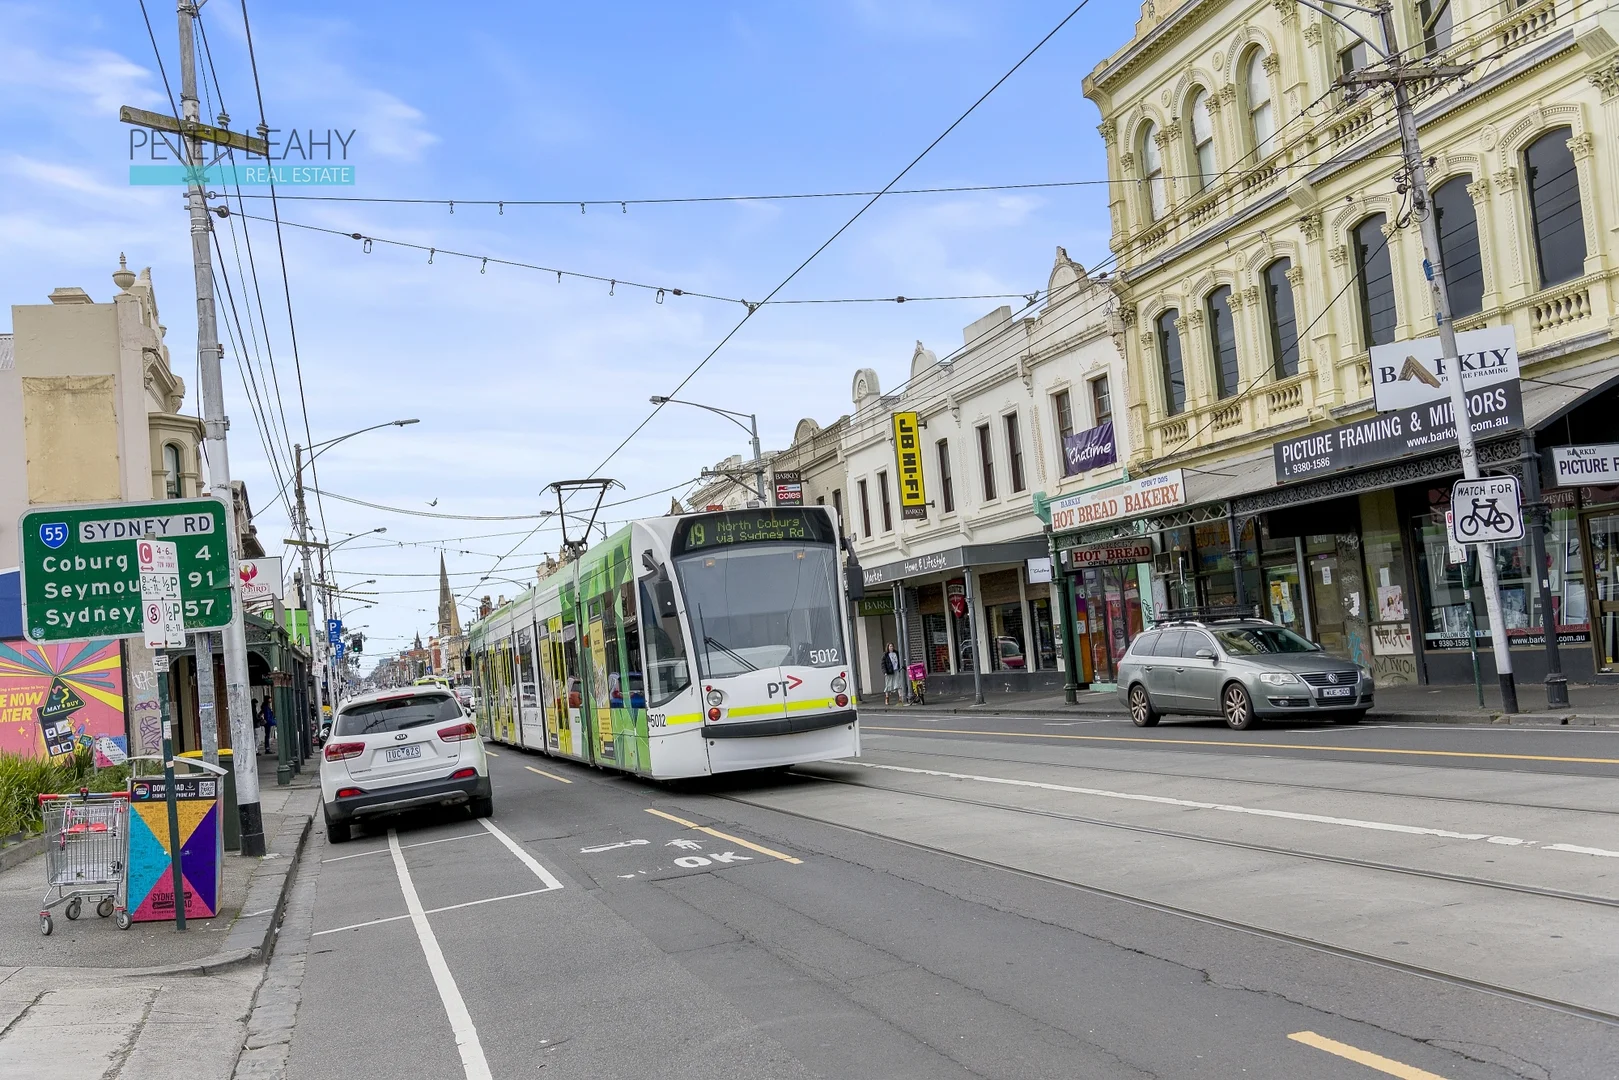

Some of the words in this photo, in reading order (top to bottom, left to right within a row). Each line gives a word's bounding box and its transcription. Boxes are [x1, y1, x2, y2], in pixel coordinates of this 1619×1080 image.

[1441, 371, 1473, 382] PIRE
[1474, 366, 1509, 378] FRAMING
[899, 418, 914, 449] JB
[1282, 434, 1333, 463] PICTURE
[1339, 416, 1402, 449] FRAMING
[1410, 411, 1422, 432] &
[1069, 441, 1111, 465] Chatime
[1292, 457, 1330, 474] 9380-1586
[1559, 457, 1609, 476] PICTURE
[1140, 479, 1153, 489] OPEN
[1457, 485, 1487, 497] WATCH
[1490, 483, 1513, 494] FOR
[778, 492, 801, 500] coles
[1053, 508, 1075, 530] HOT
[1078, 499, 1118, 524] BREAD
[1123, 483, 1180, 514] BAKERY
[45, 527, 63, 541] 55
[84, 519, 171, 540] SYDNEY
[184, 516, 210, 533] RD
[717, 521, 752, 533] North
[716, 533, 734, 544] via
[740, 530, 784, 541] Sydney
[790, 527, 804, 538] Rd
[42, 554, 128, 573] Coburg
[195, 545, 211, 561] 4
[1073, 550, 1101, 563] HOT
[1106, 546, 1151, 560] BREAD
[904, 561, 919, 573] Home
[44, 579, 140, 600] Seymou
[188, 570, 213, 588] 91
[45, 606, 136, 629] Sydney
[1438, 638, 1470, 648] 9380-1586
[810, 648, 839, 664] 5012
[10, 691, 44, 707] NOW
[46, 704, 61, 713] MAY
[66, 699, 79, 708] BUY
[0, 707, 33, 723] ATER
[651, 713, 667, 728] 5012
[152, 783, 185, 792] DOWAD
[152, 892, 174, 901] SYDNE
